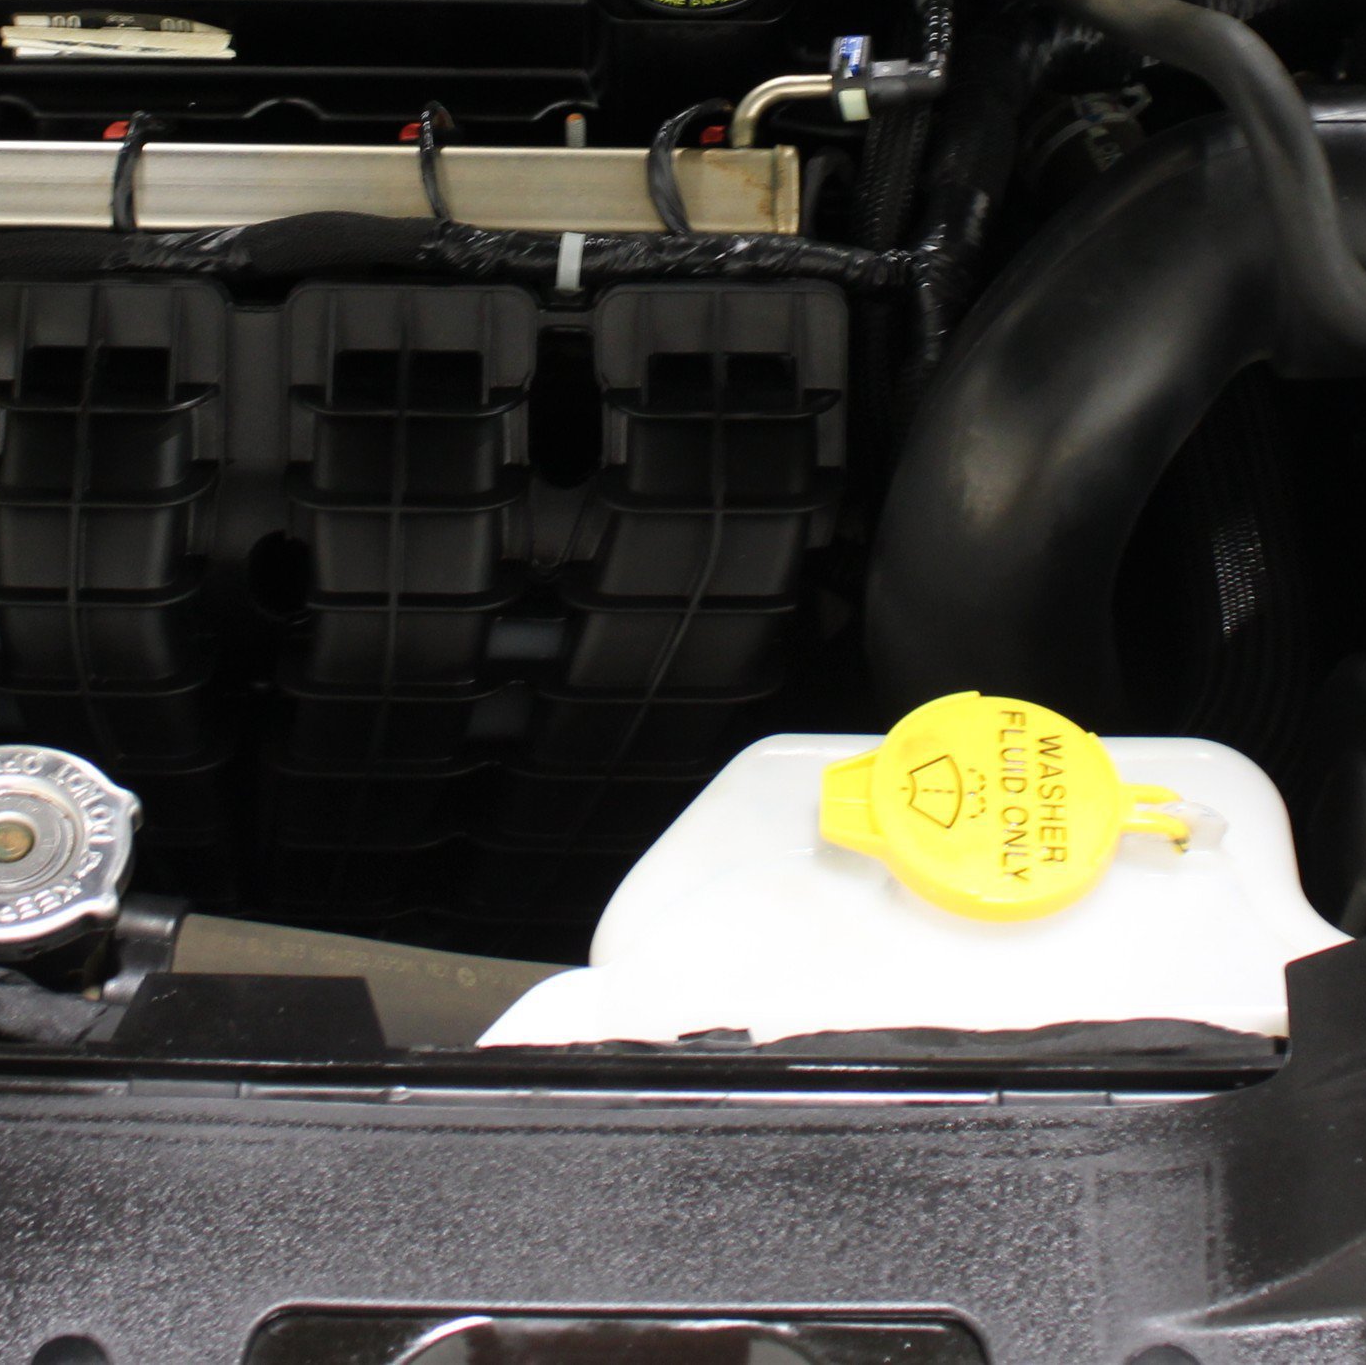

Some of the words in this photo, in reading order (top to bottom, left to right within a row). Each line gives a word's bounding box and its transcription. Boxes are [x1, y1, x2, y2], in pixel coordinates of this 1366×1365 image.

[999, 710, 1027, 794] FLUID
[1037, 734, 1067, 863] WASHER
[1001, 806, 1029, 881] ONLY
